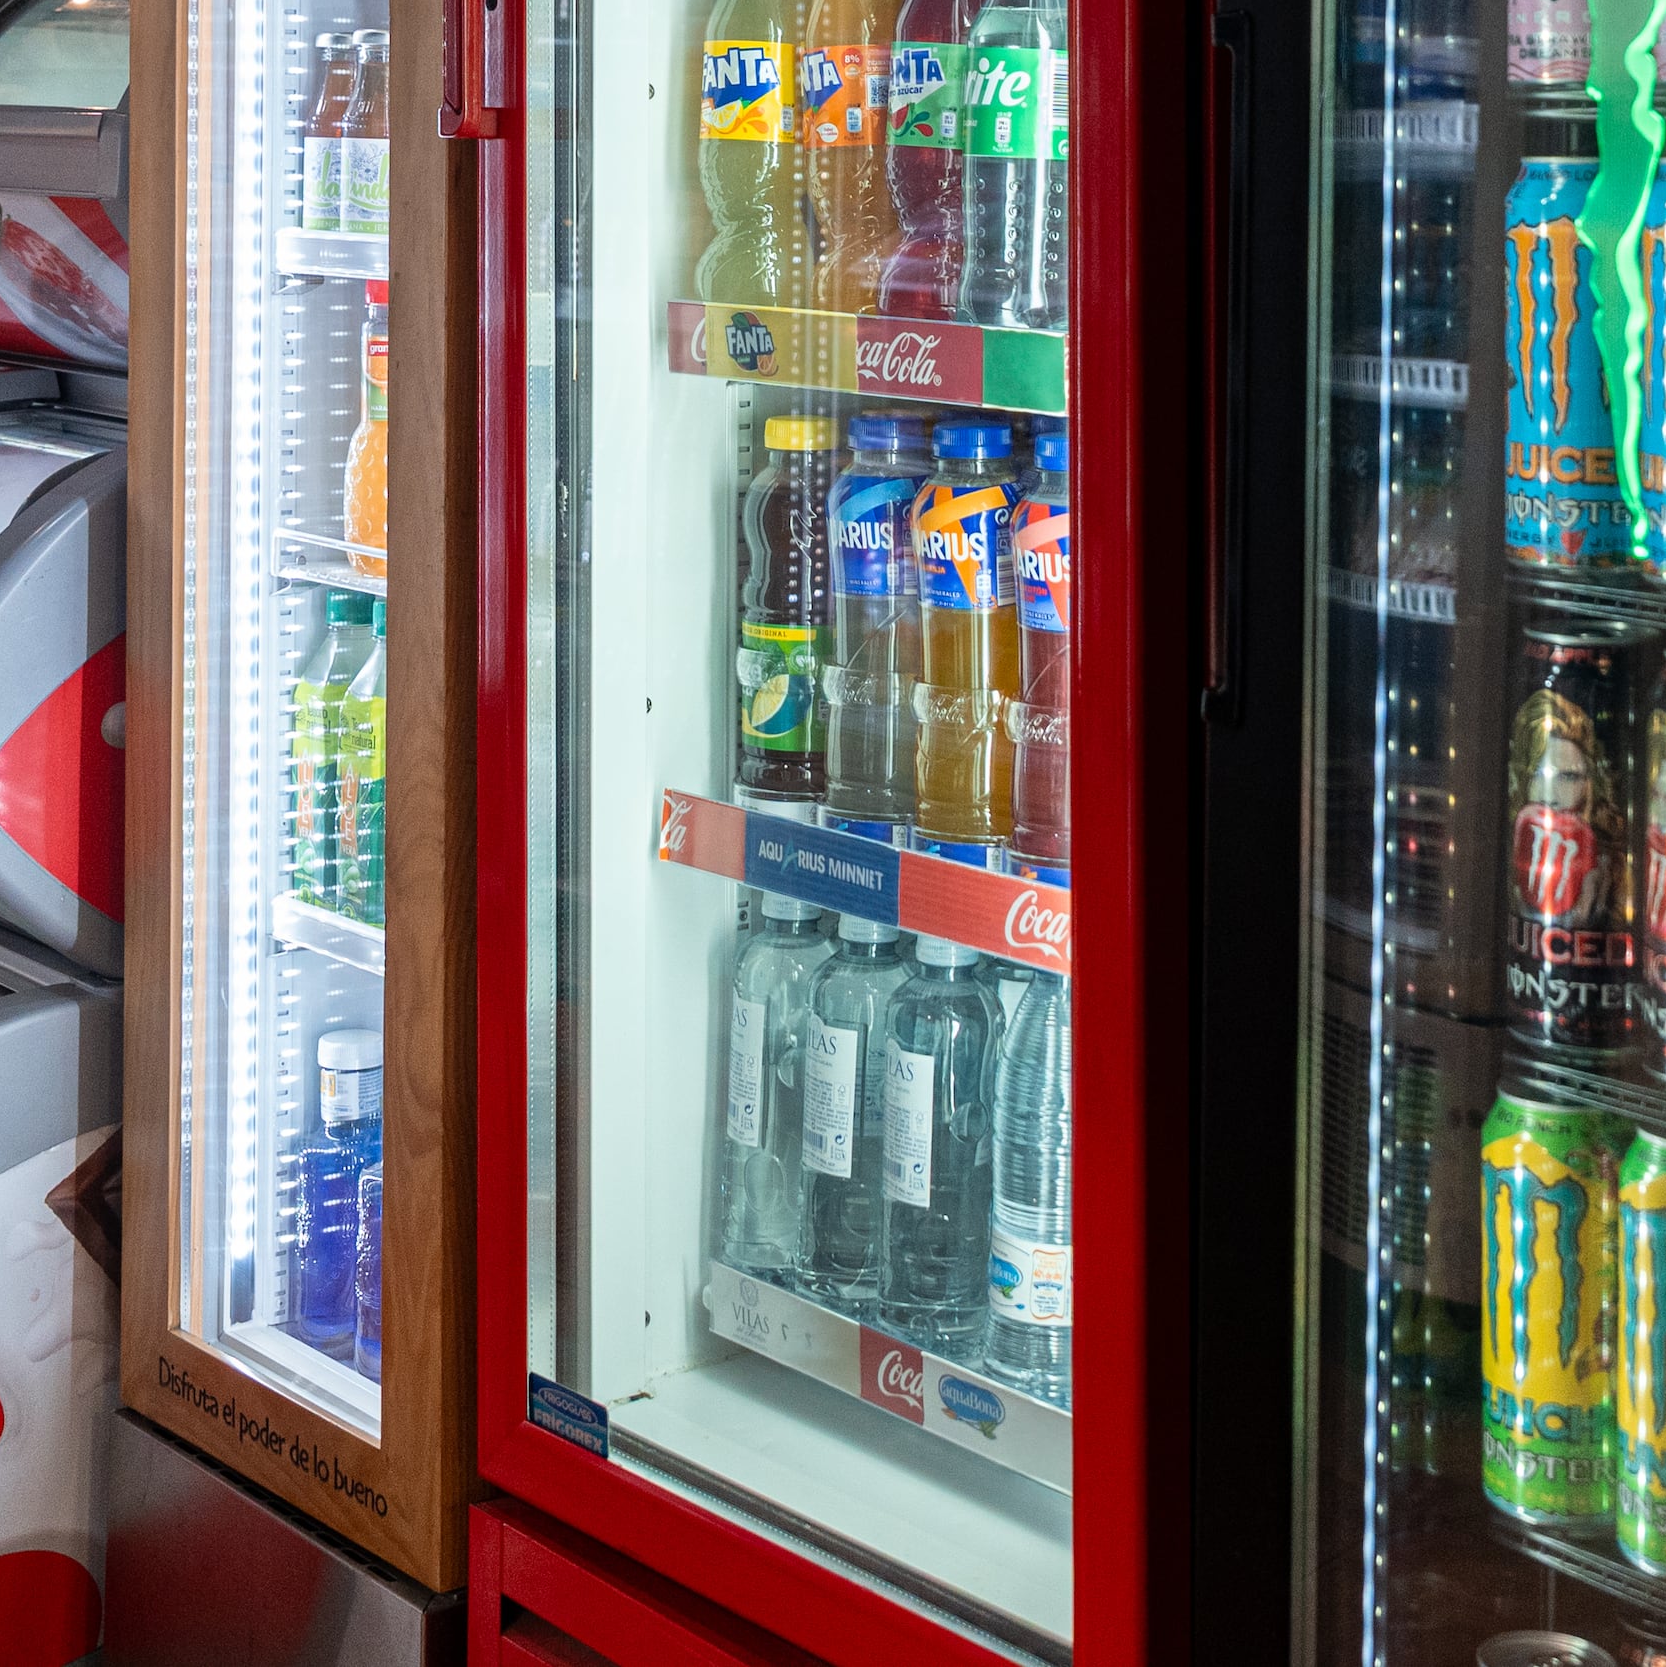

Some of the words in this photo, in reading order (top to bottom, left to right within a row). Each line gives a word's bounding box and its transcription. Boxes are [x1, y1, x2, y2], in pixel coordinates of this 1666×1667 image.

[898, 86, 924, 99] azúcar
[726, 324, 774, 354] FANTA
[1506, 443, 1619, 485] JUICE
[758, 839, 826, 876] AQUARIUS
[1004, 890, 1071, 961] Coca-
[732, 1301, 770, 1335] VILAS
[941, 1381, 1000, 1422] aquaBona
[158, 1355, 219, 1418] Disfruta
[222, 1398, 236, 1429] el
[239, 1417, 286, 1455] poder
[289, 1436, 310, 1473] de
[312, 1445, 330, 1483] lo
[333, 1458, 389, 1518] bueno
[534, 1408, 603, 1453] FRIGOREX
